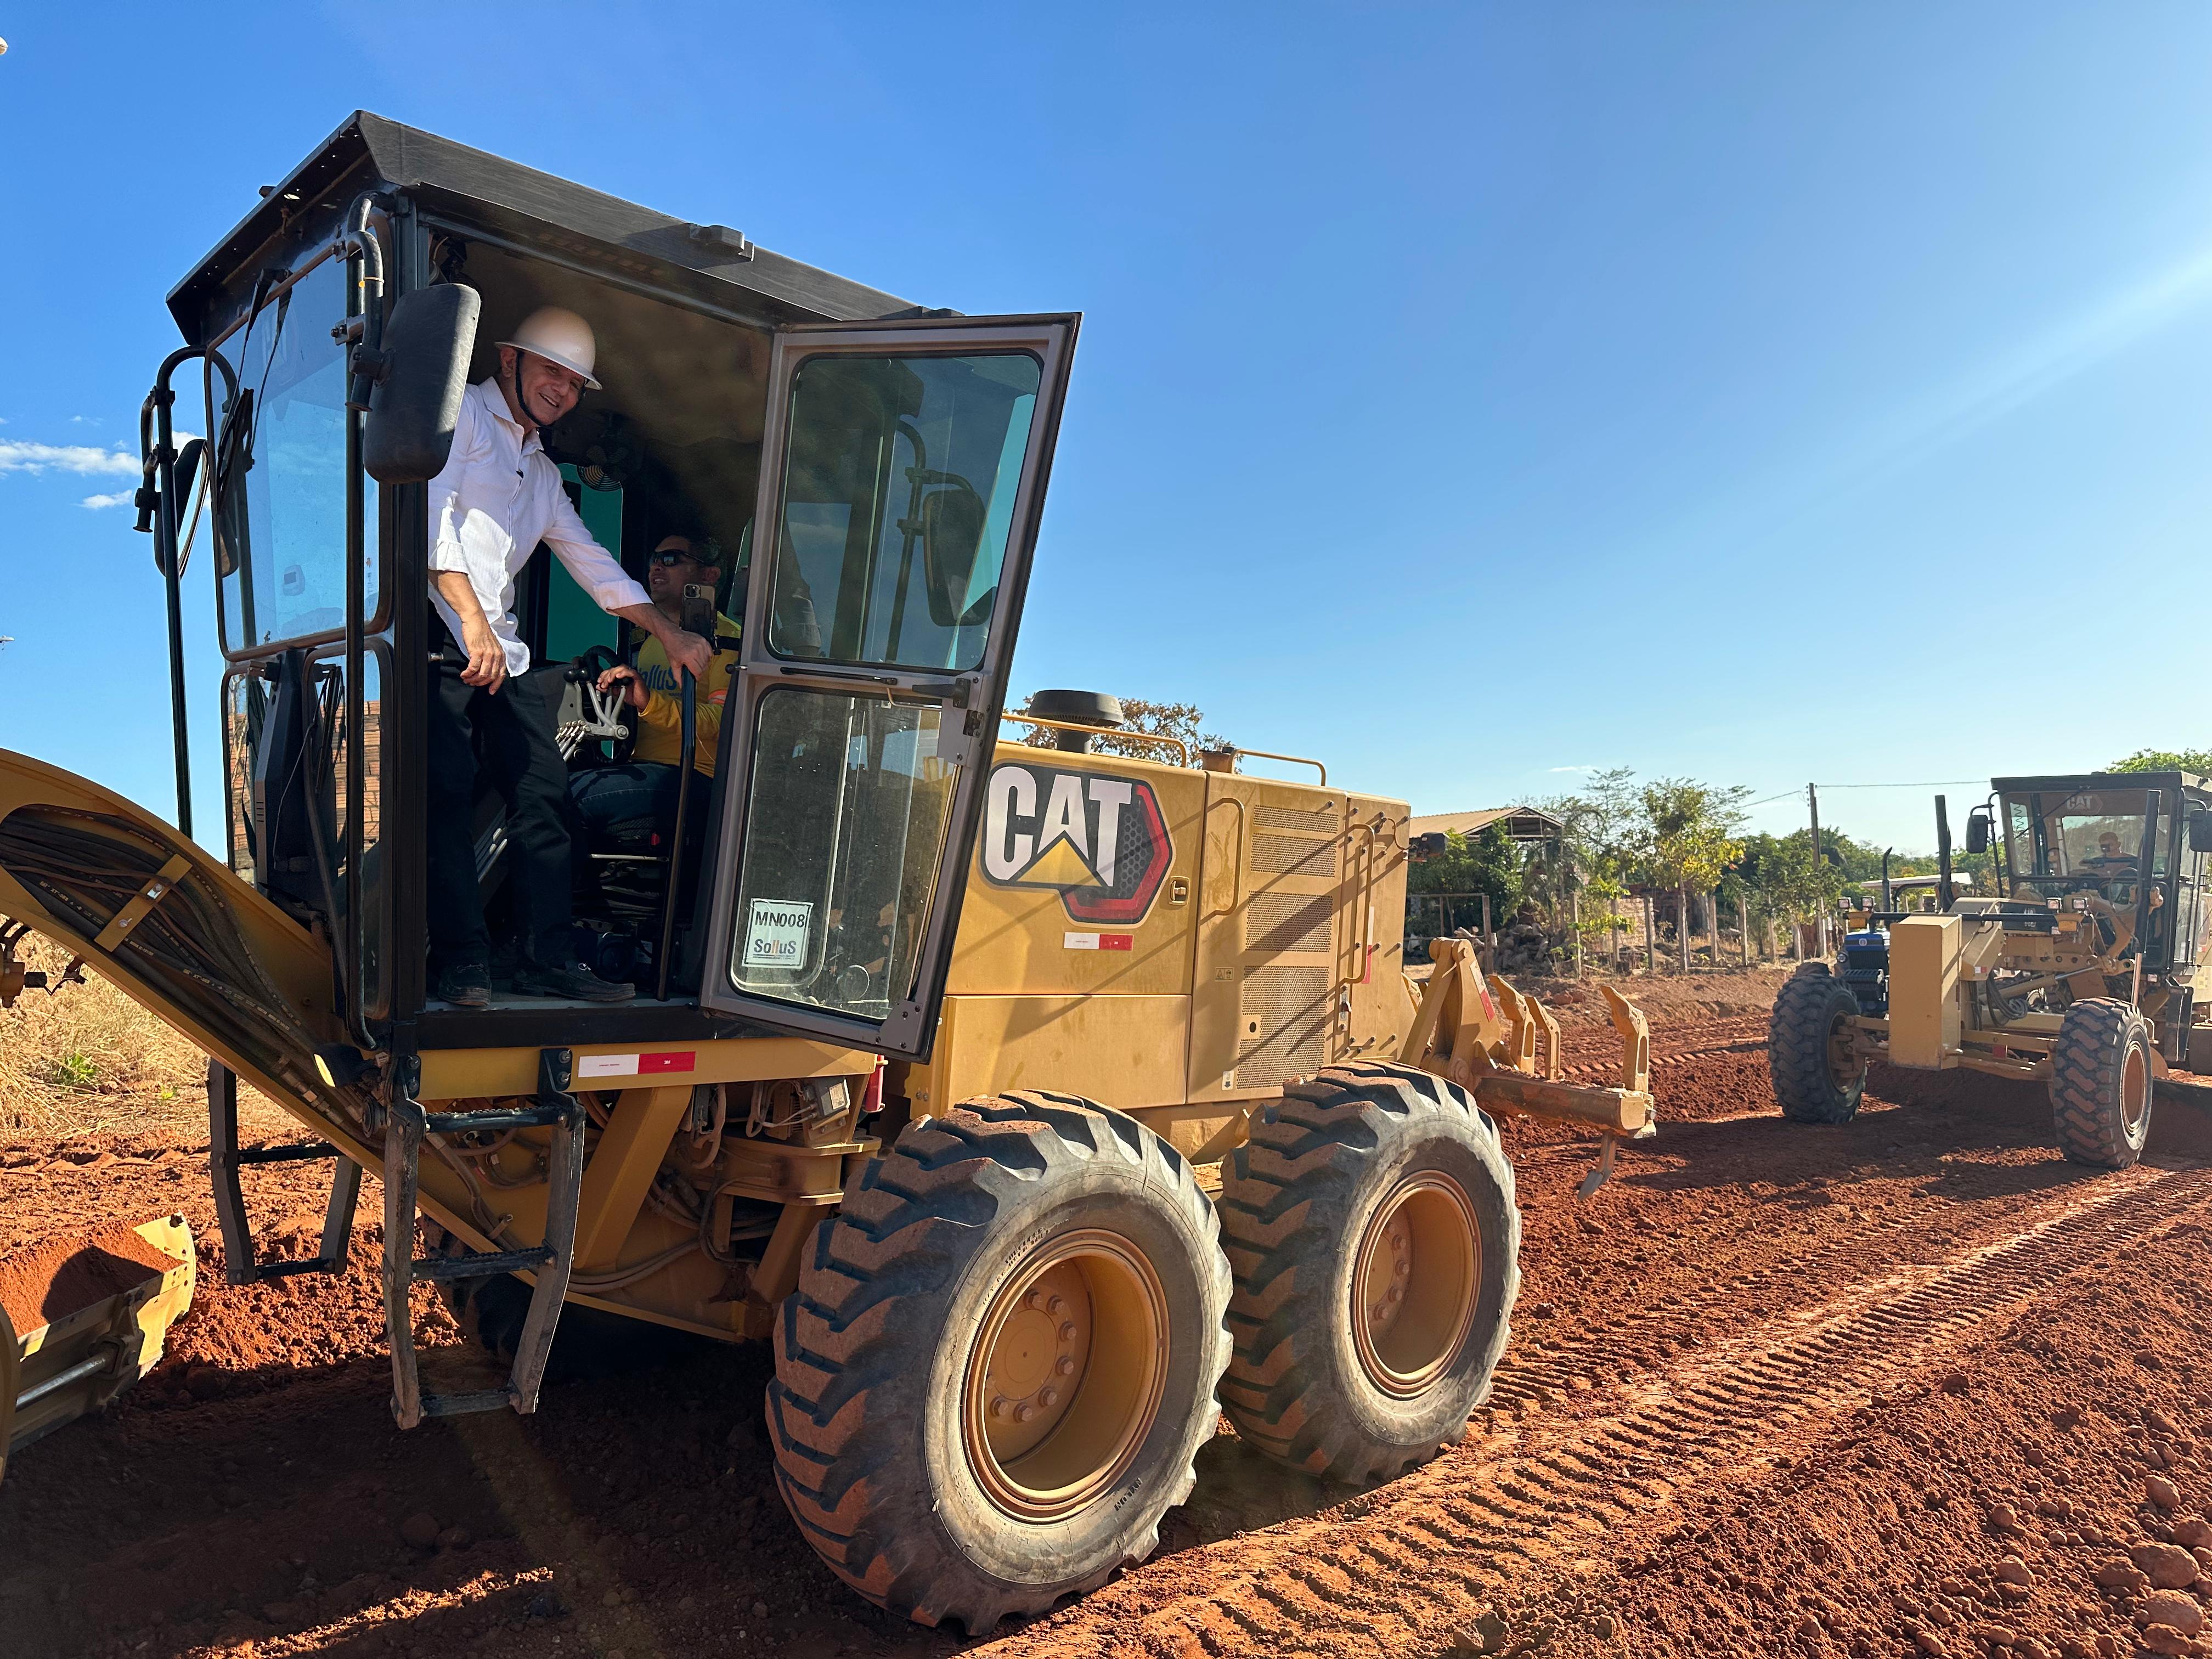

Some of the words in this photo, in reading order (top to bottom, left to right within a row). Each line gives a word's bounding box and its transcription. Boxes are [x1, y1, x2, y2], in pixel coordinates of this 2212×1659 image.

[2066, 795, 2092, 810] CAT
[985, 766, 1132, 887] CAT
[754, 911, 805, 927] MN008
[1114, 1477, 1143, 1511] NYLON
